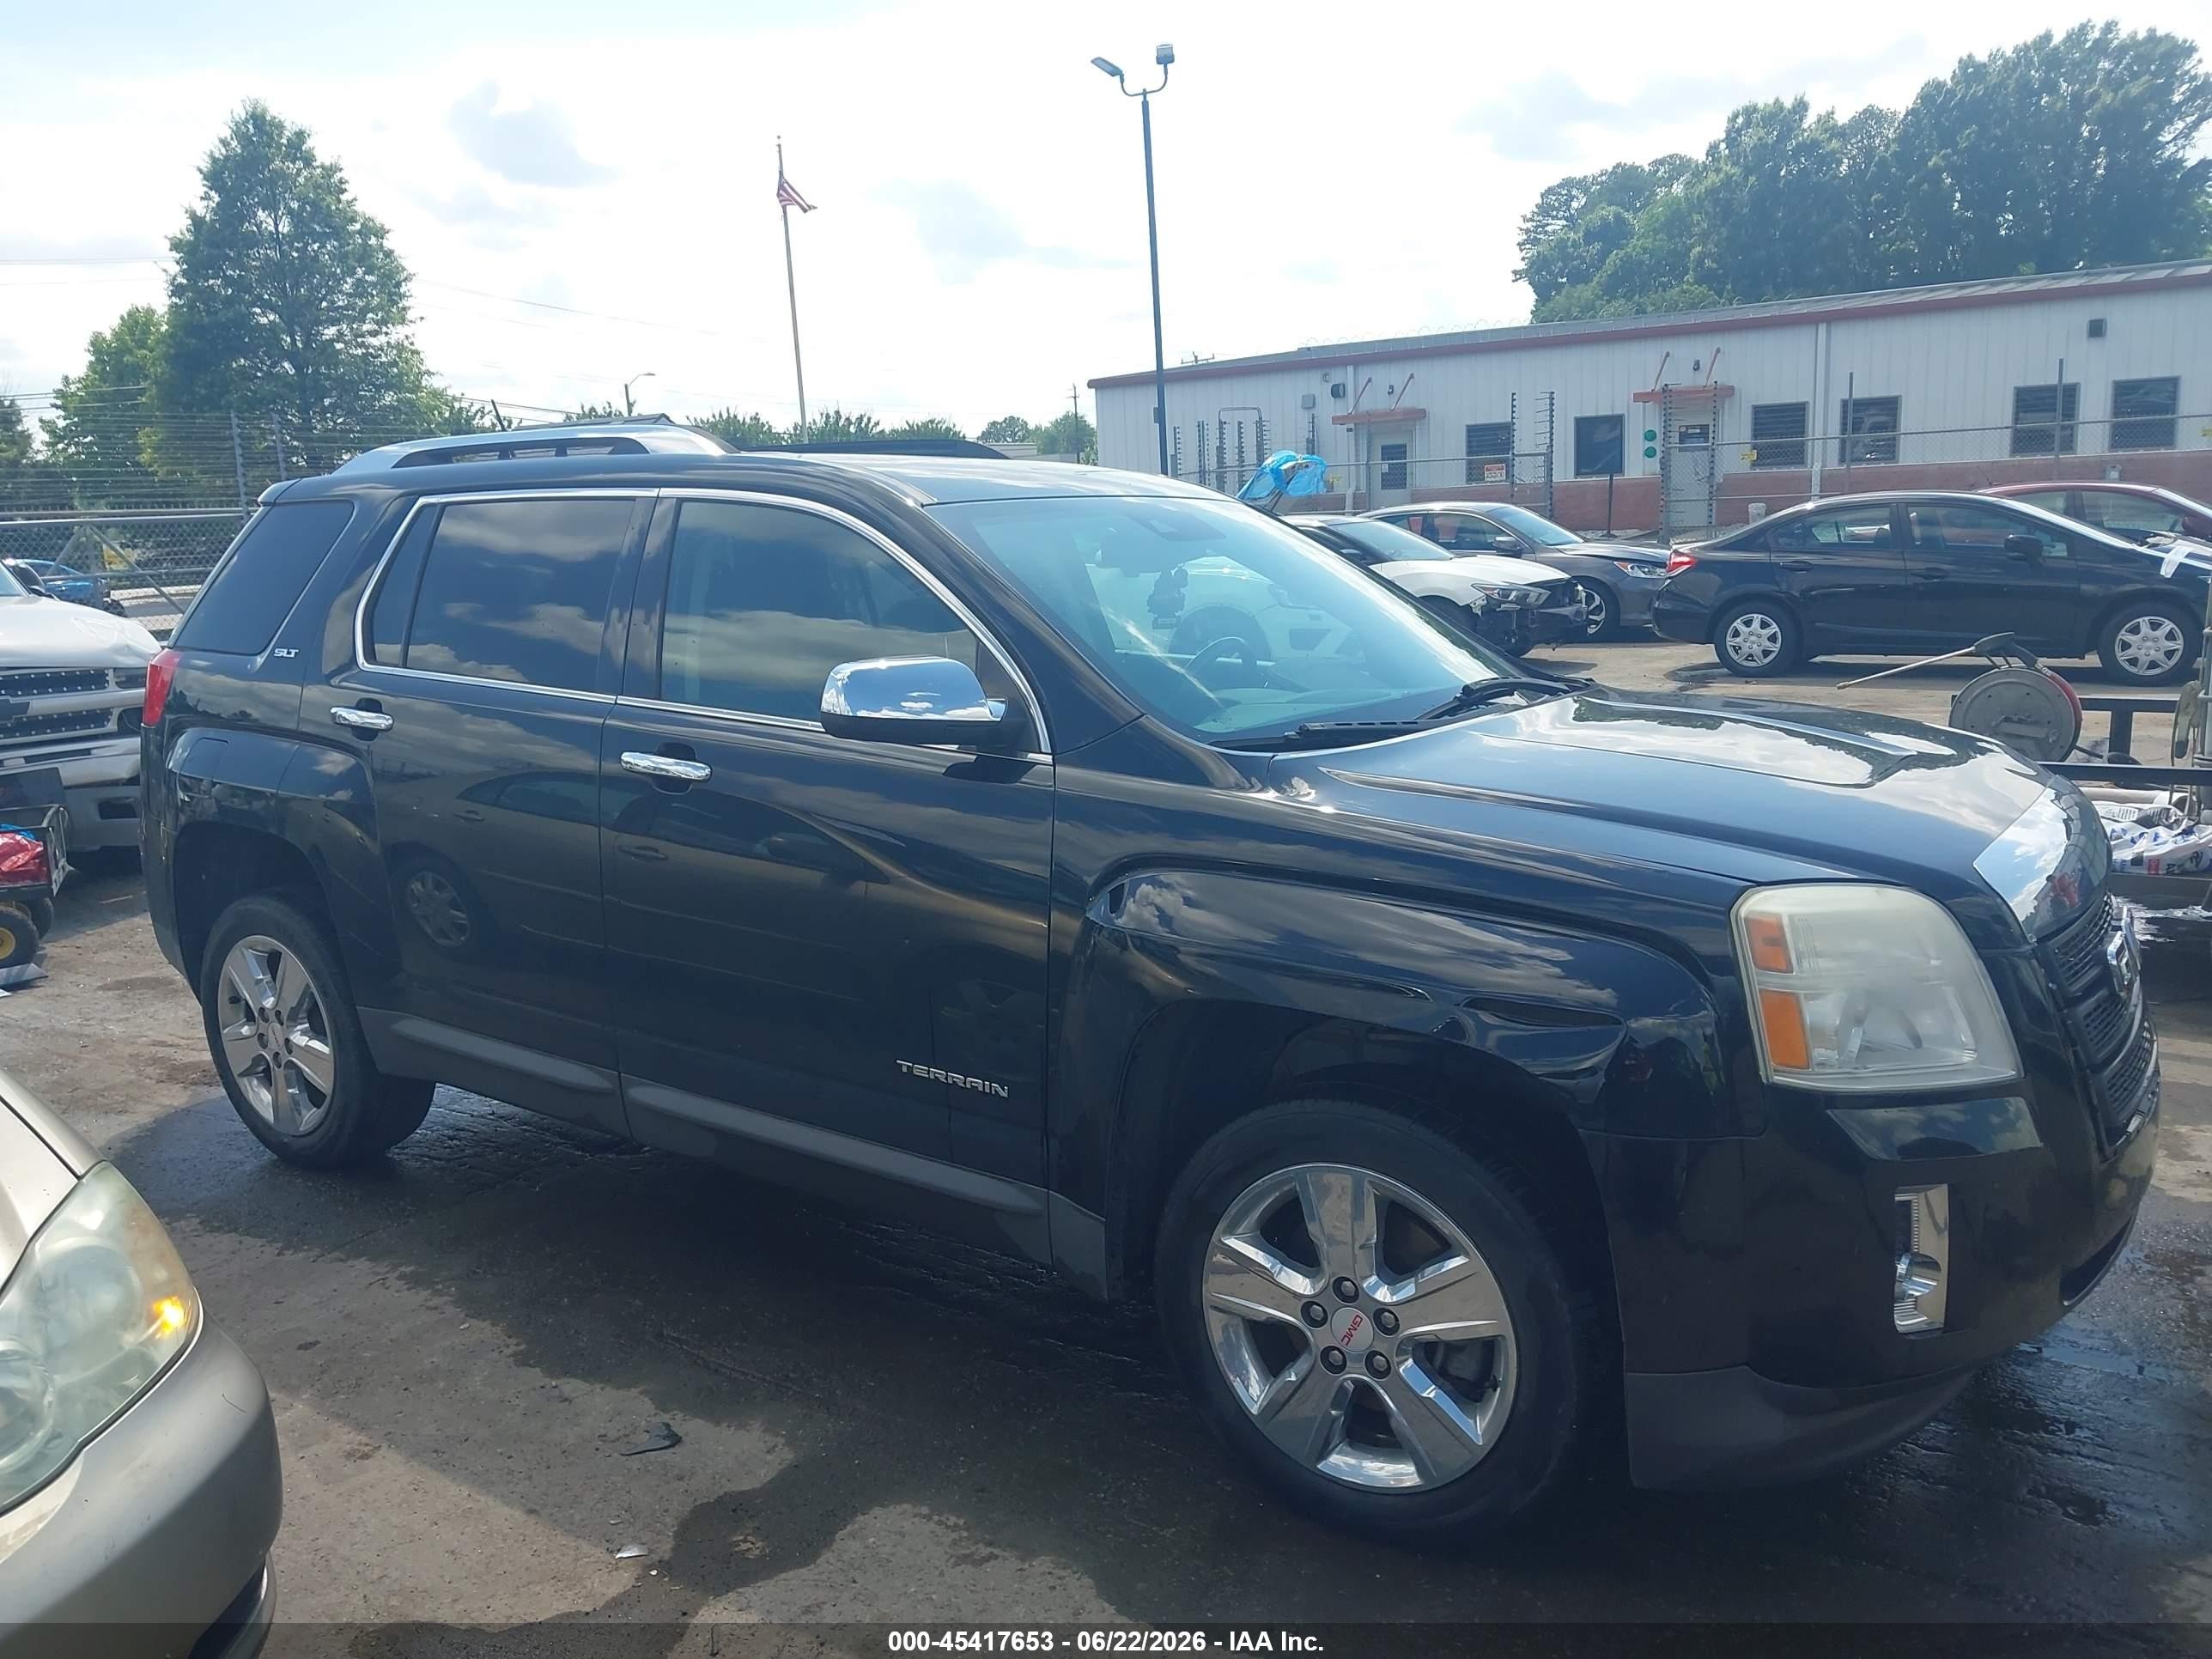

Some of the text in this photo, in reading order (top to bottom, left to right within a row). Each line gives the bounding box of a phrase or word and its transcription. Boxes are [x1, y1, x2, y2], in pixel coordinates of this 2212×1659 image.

[274, 648, 299, 658] SLT
[896, 1060, 1008, 1098] TERRAIN
[1340, 1315, 1364, 1346] GMC
